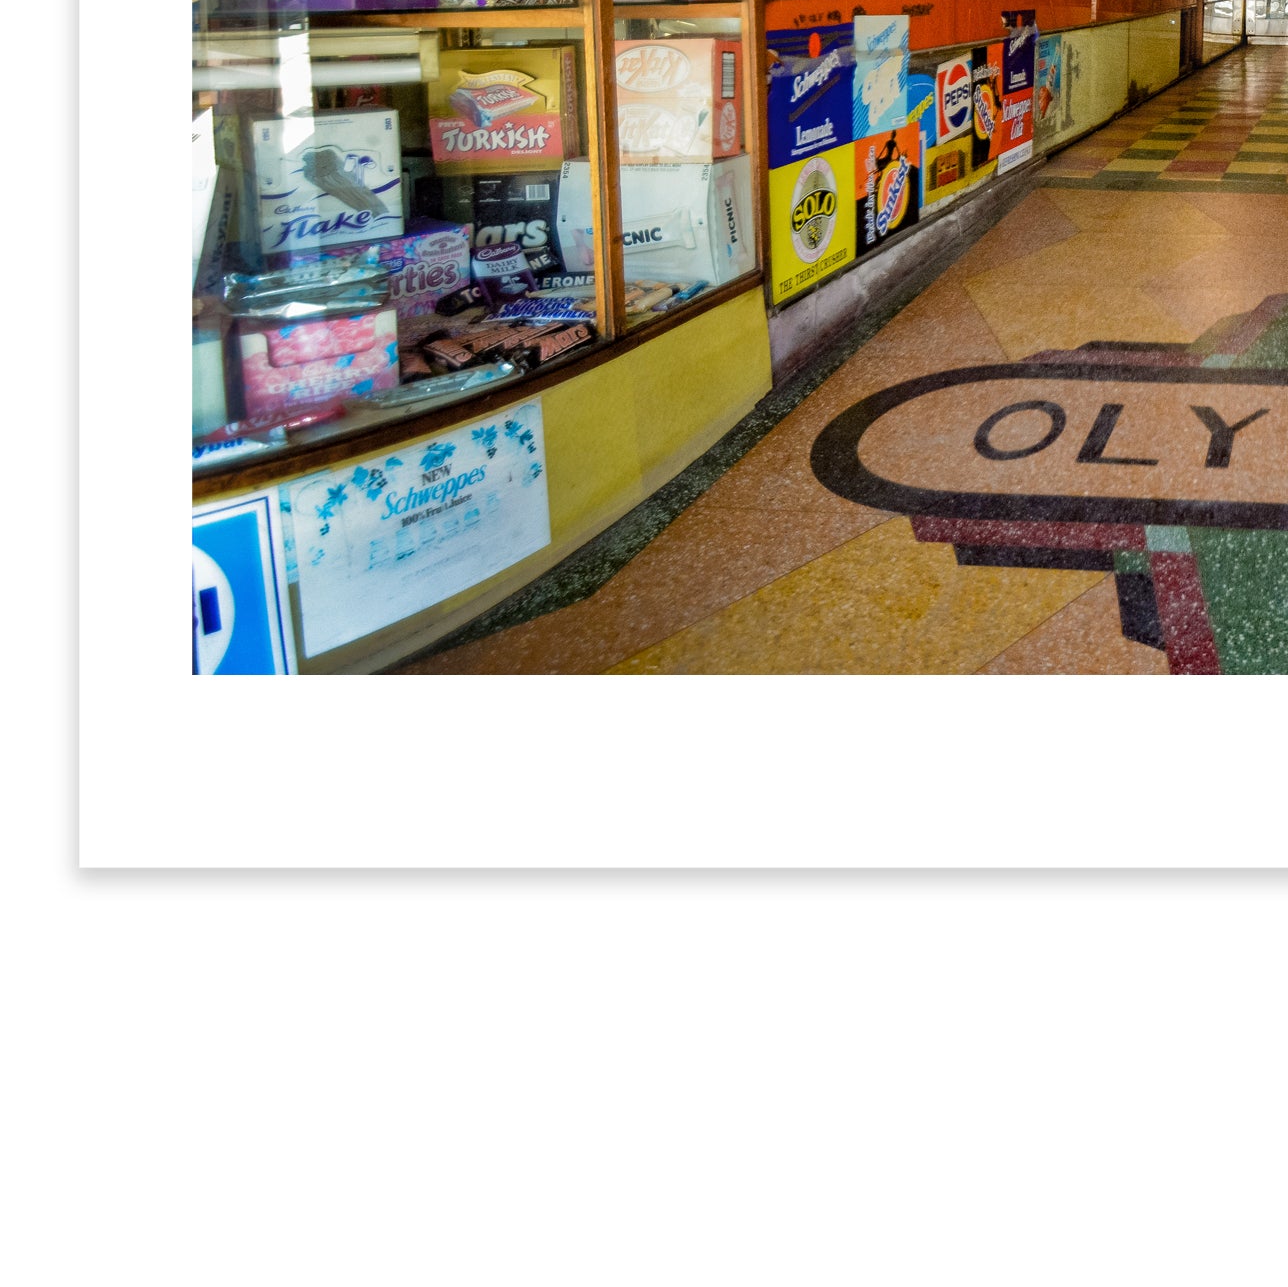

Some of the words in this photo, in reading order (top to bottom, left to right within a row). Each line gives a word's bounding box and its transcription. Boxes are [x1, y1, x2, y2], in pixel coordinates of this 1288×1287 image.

[790, 48, 842, 103] Schweppes
[477, 88, 522, 106] TURKISH
[943, 82, 972, 110] PEPSI
[441, 122, 550, 153] TURKISH
[562, 162, 571, 179] 2354
[792, 191, 836, 231] SOLO
[876, 155, 911, 236] Sunkist
[272, 209, 373, 248] Flake
[475, 219, 550, 249] ars
[722, 198, 739, 244] PICNIC
[476, 242, 520, 261] Cadbury
[486, 258, 519, 269] DAIRY
[489, 265, 518, 275] MILK
[779, 275, 793, 295] THE
[795, 264, 820, 286] THIRST
[820, 248, 848, 272] CRUSHER
[540, 323, 590, 362] Mars
[421, 463, 453, 487] NEW
[380, 464, 488, 521] Schweppes
